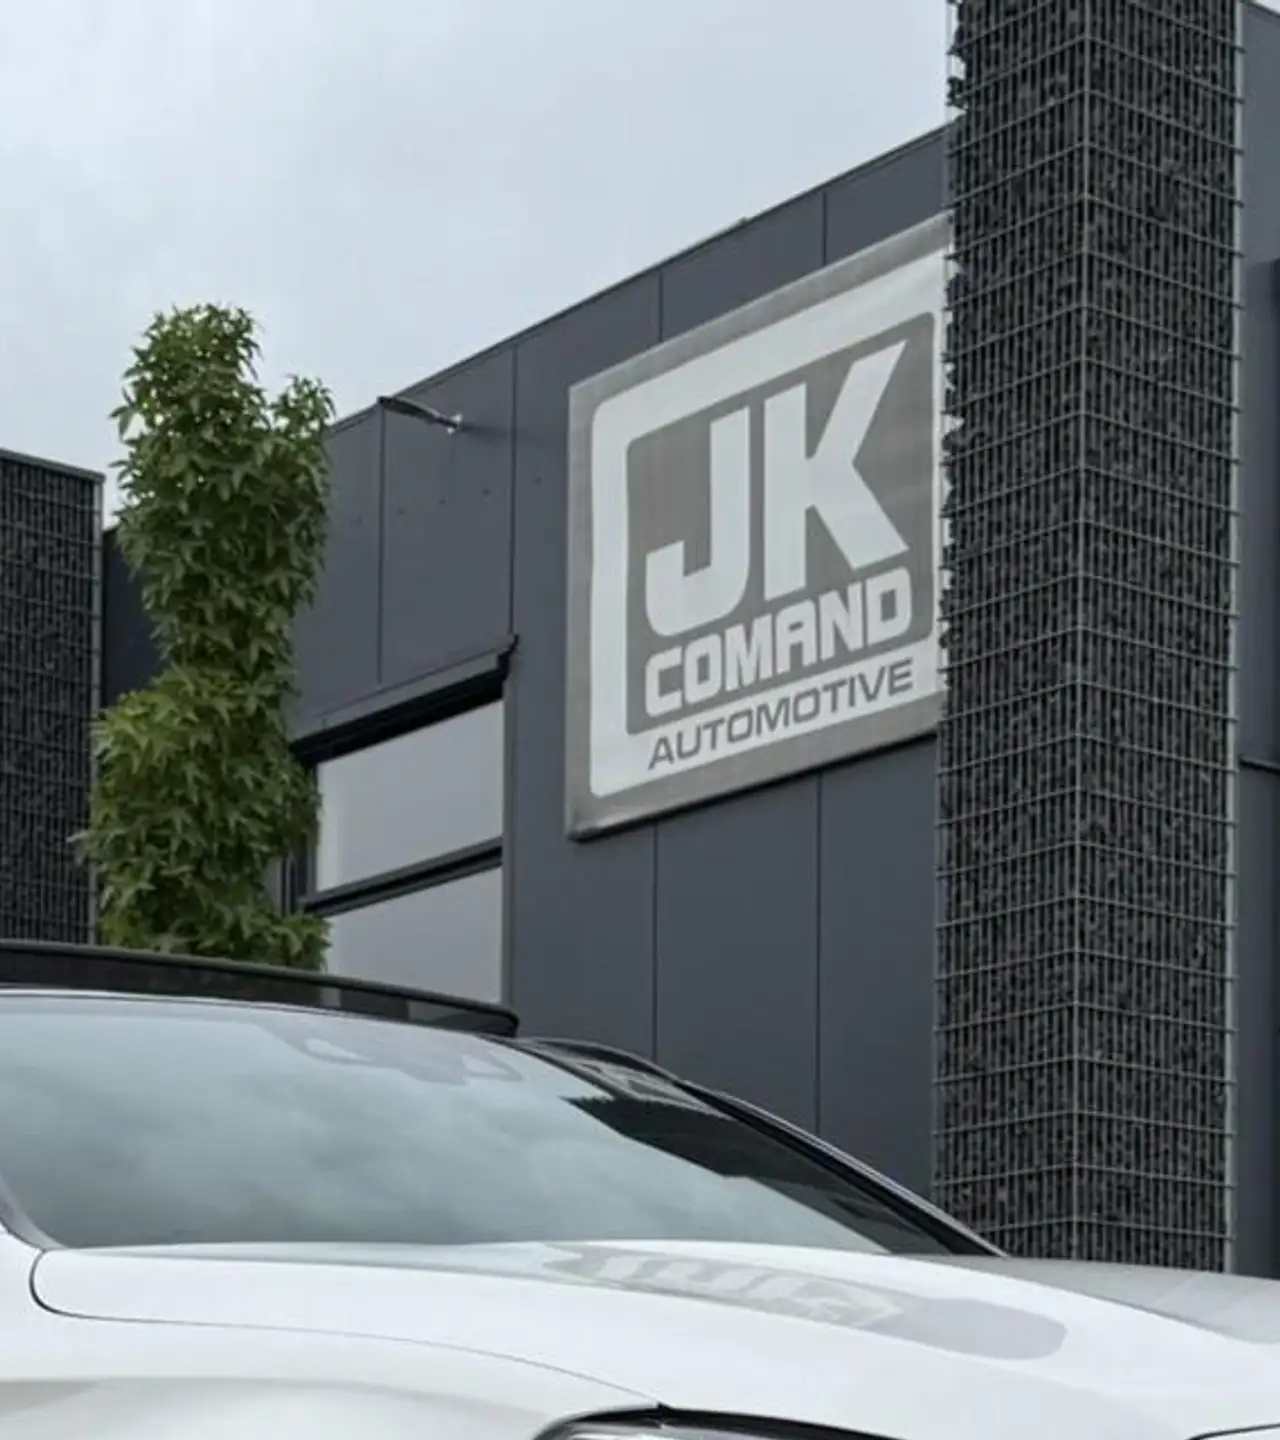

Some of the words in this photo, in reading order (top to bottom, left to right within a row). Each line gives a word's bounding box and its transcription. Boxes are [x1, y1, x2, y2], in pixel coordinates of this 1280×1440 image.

[646, 339, 909, 637] JK
[645, 566, 912, 718] COMAND
[648, 657, 914, 771] AUTOMOTIVE
